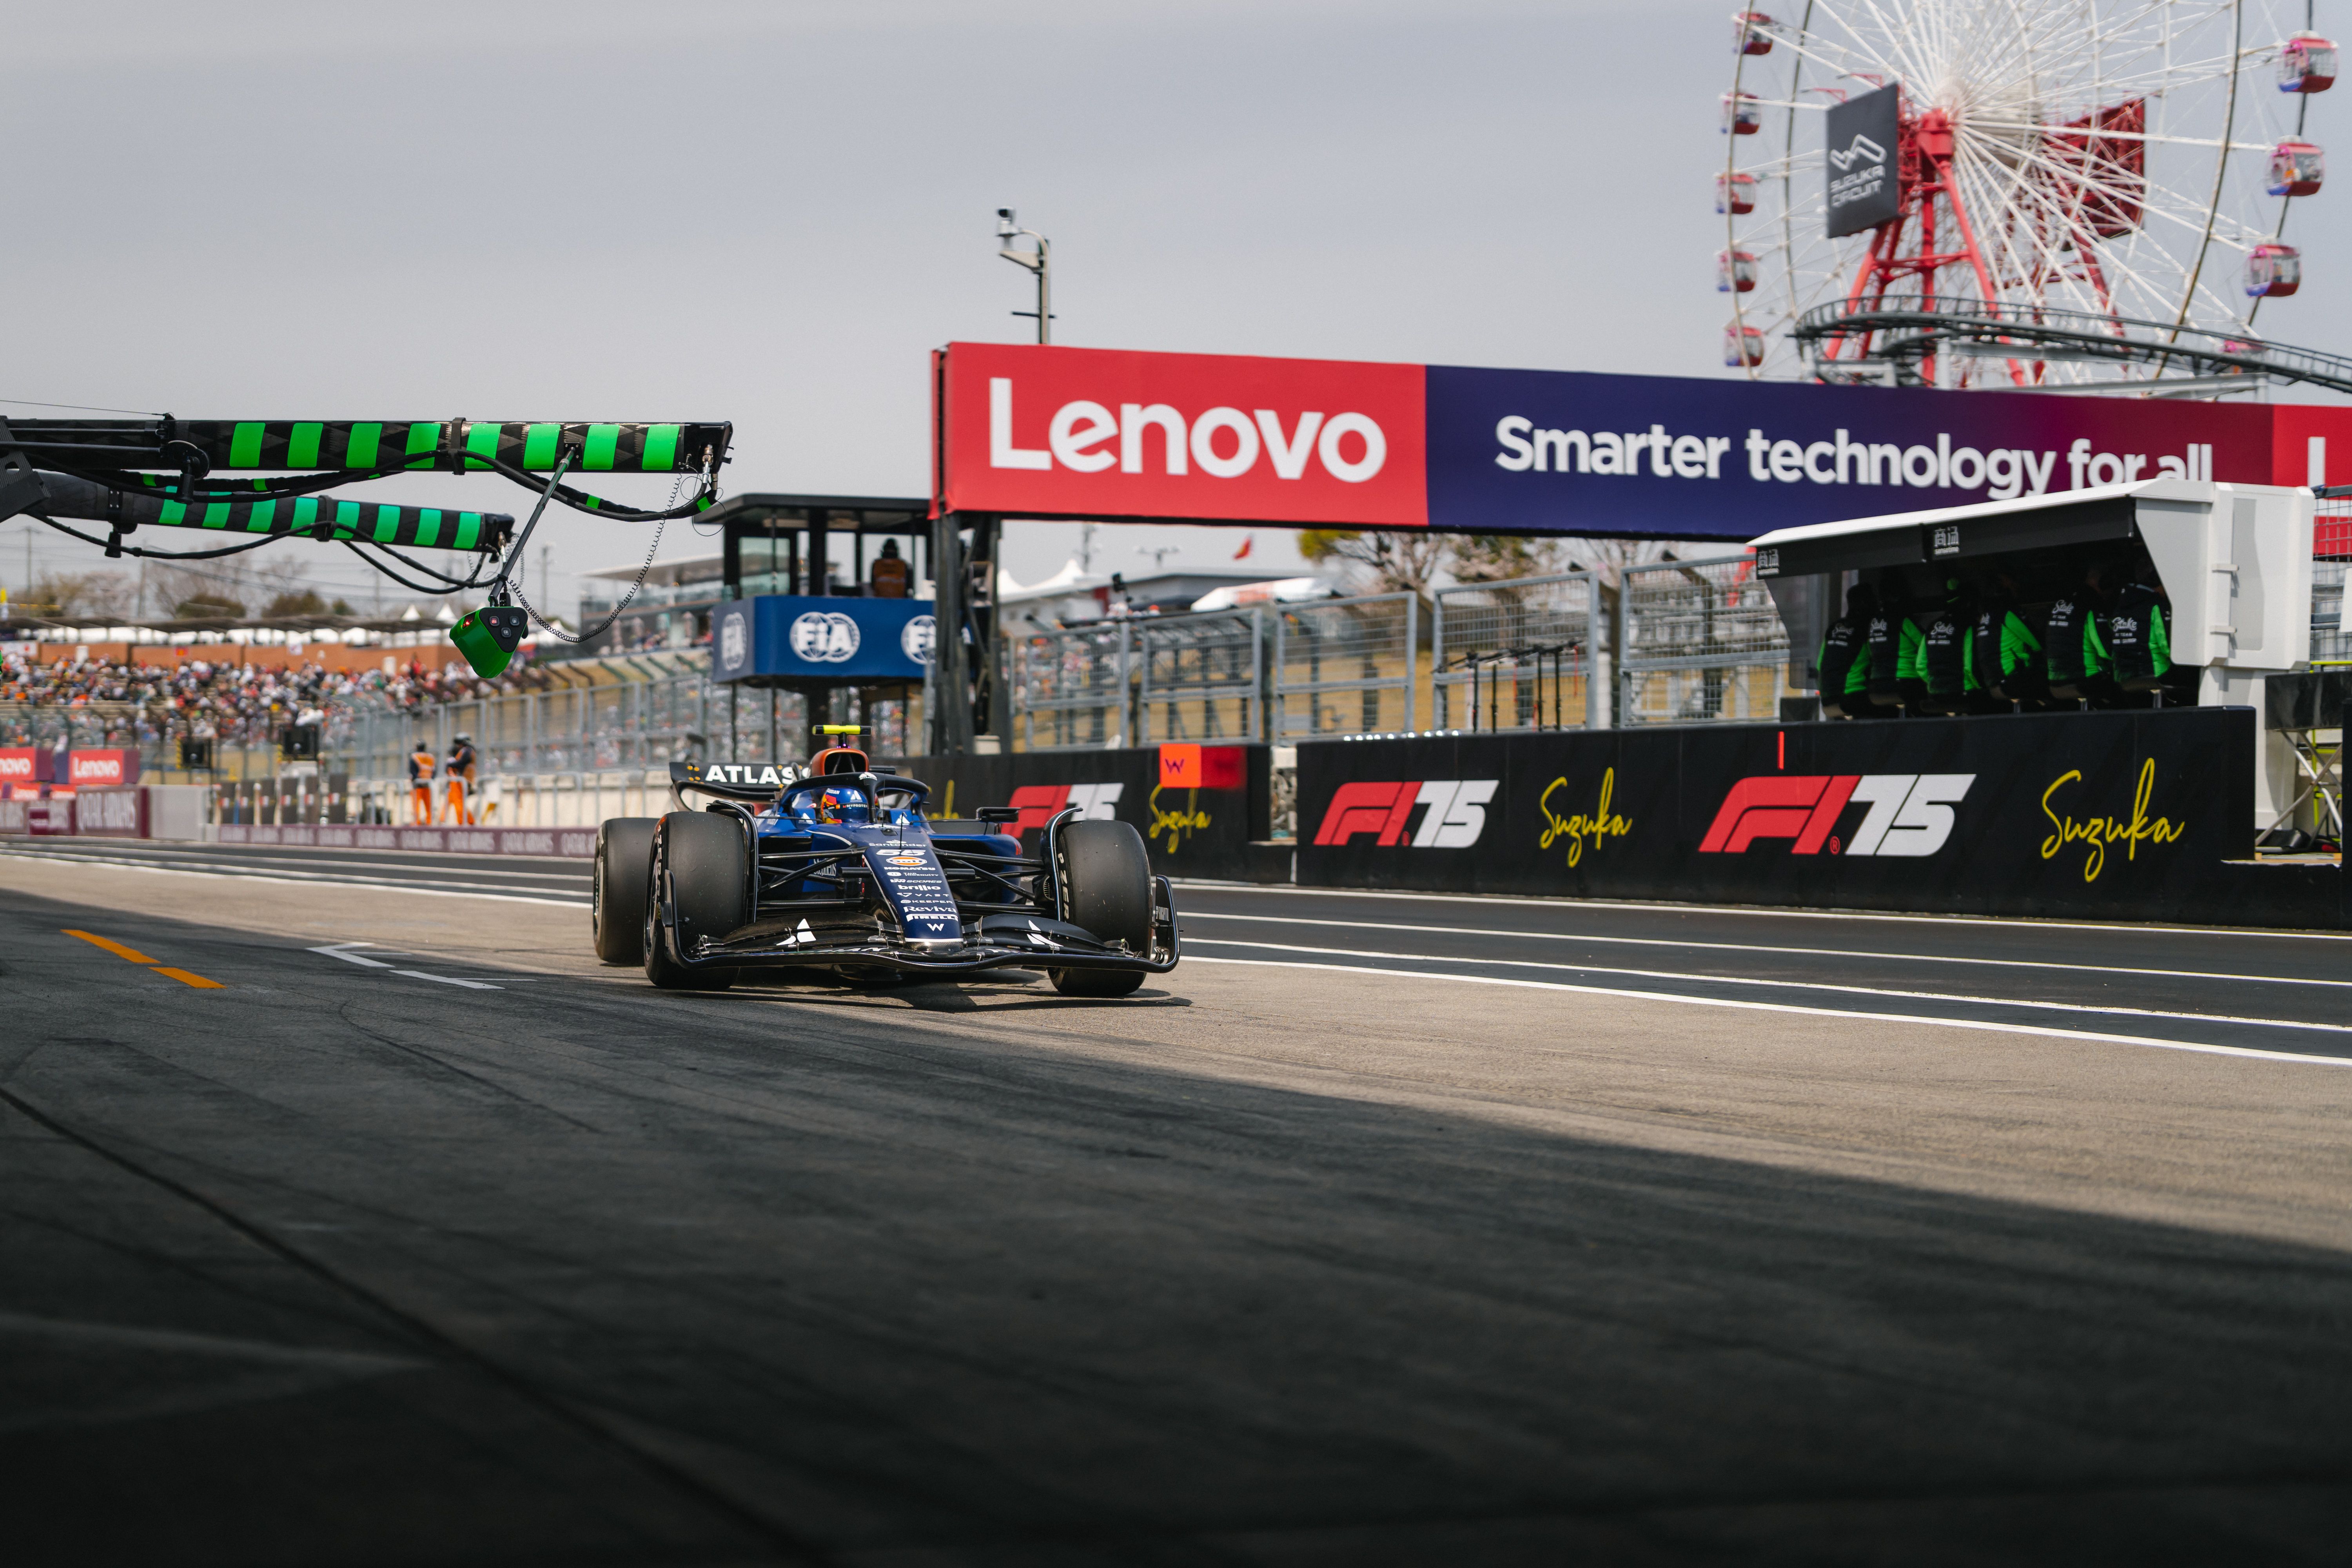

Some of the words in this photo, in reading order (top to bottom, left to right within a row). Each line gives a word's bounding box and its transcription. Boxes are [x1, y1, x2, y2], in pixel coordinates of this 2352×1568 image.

[1830, 165, 1886, 194] SUZUKA
[1831, 180, 1883, 208] CIRCUIT
[989, 376, 1387, 484] Lenovo
[1494, 415, 1730, 481] Smarter
[1745, 427, 2057, 501] technology
[2067, 438, 2147, 490] for
[2156, 443, 2213, 482] all
[1935, 546, 1960, 555] sensetime
[2111, 617, 2138, 632] Stake
[73, 757, 120, 778] Lenovo
[1164, 758, 1185, 774] W
[1313, 780, 1423, 847] F1
[1410, 779, 1500, 848] 75
[1539, 767, 1633, 868] Suzuka
[1699, 775, 1863, 855] F1
[1844, 773, 1977, 857] 75
[2041, 757, 2185, 883] Suzuka
[1060, 869, 1069, 922] ZER
[906, 913, 958, 922] PIRELLI
[926, 923, 944, 931] W
